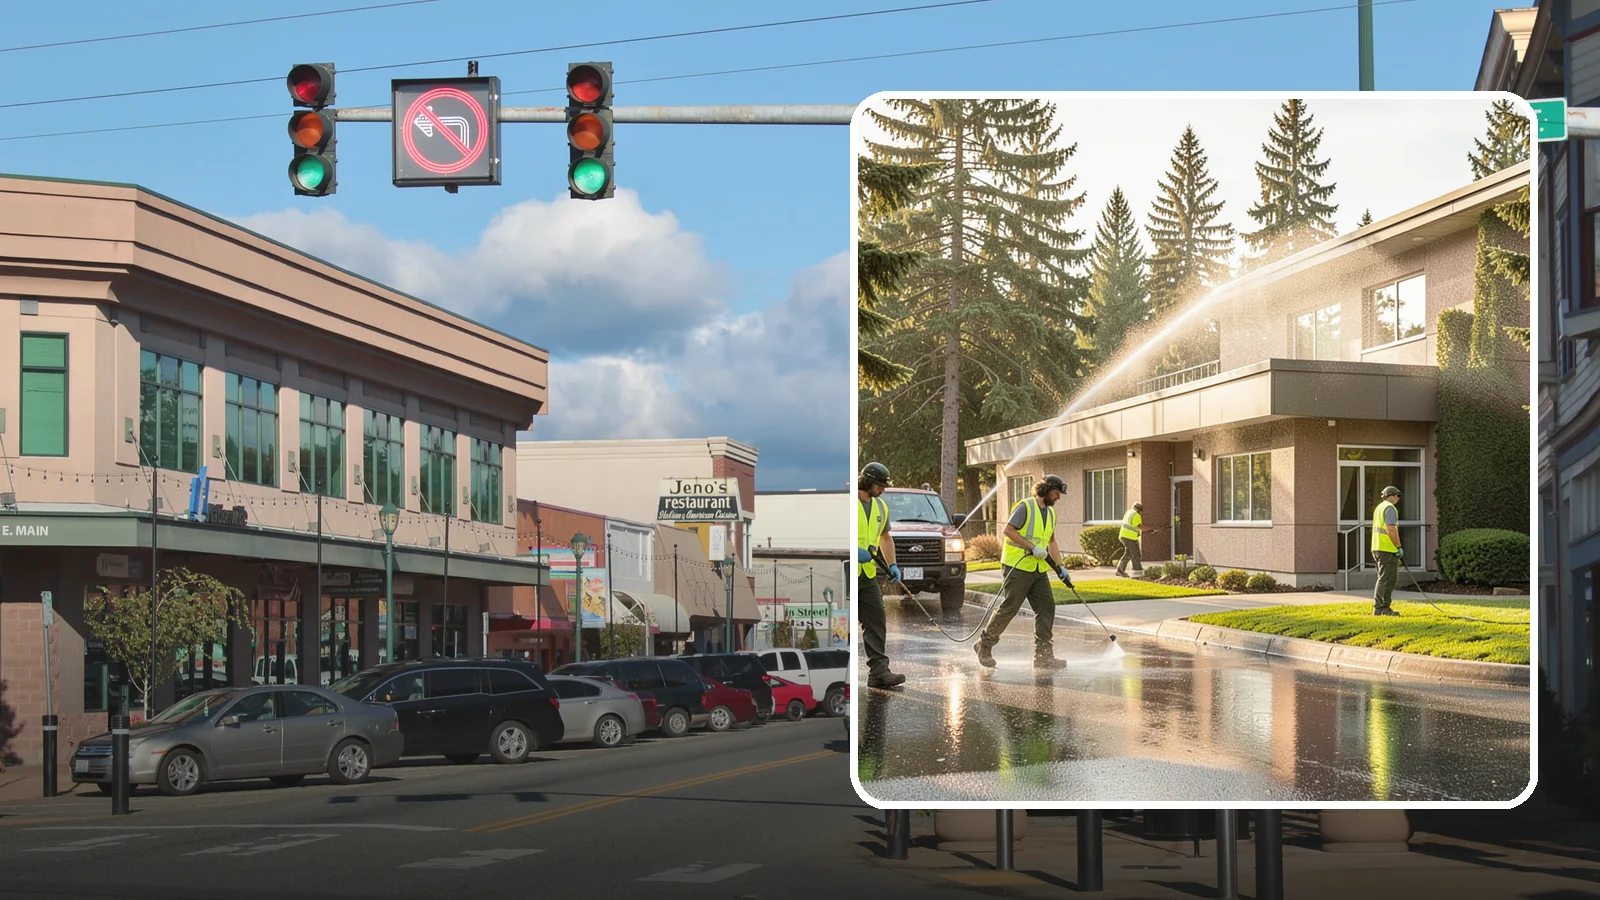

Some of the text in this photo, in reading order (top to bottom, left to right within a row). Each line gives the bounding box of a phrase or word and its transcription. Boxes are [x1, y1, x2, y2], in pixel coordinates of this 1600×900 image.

[669, 480, 727, 494] Jeno's
[665, 496, 731, 509] restaurant
[658, 510, 681, 520] Italian
[685, 509, 714, 519] American
[715, 509, 738, 519] Cuisine
[2, 525, 49, 536] E. MAIN
[797, 607, 828, 617] Street
